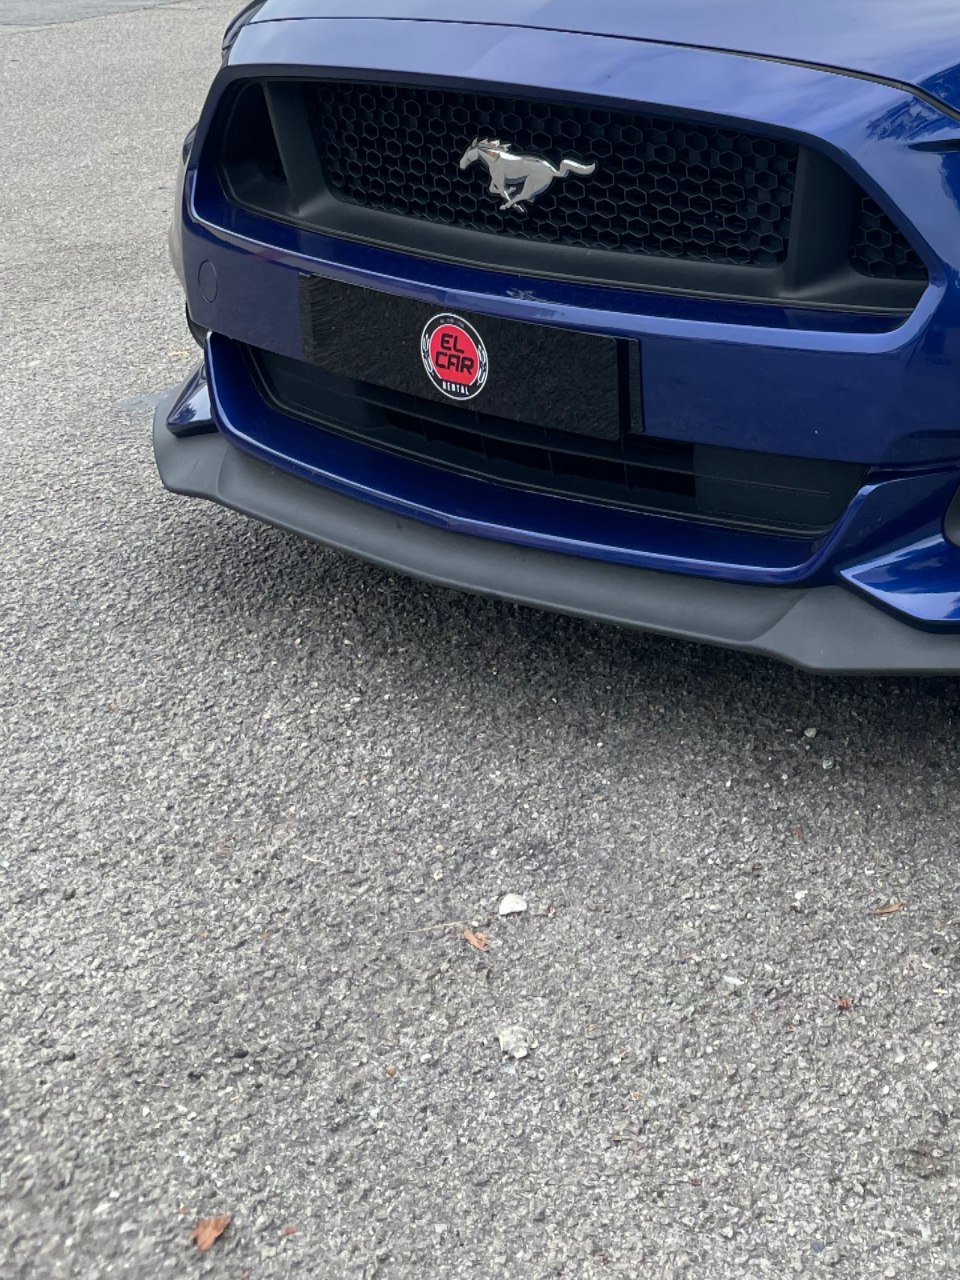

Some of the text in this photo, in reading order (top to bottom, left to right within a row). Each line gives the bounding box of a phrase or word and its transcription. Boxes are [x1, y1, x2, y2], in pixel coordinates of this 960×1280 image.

[441, 333, 464, 353] EL
[435, 350, 475, 375] CAR
[442, 381, 469, 395] RENTAL
